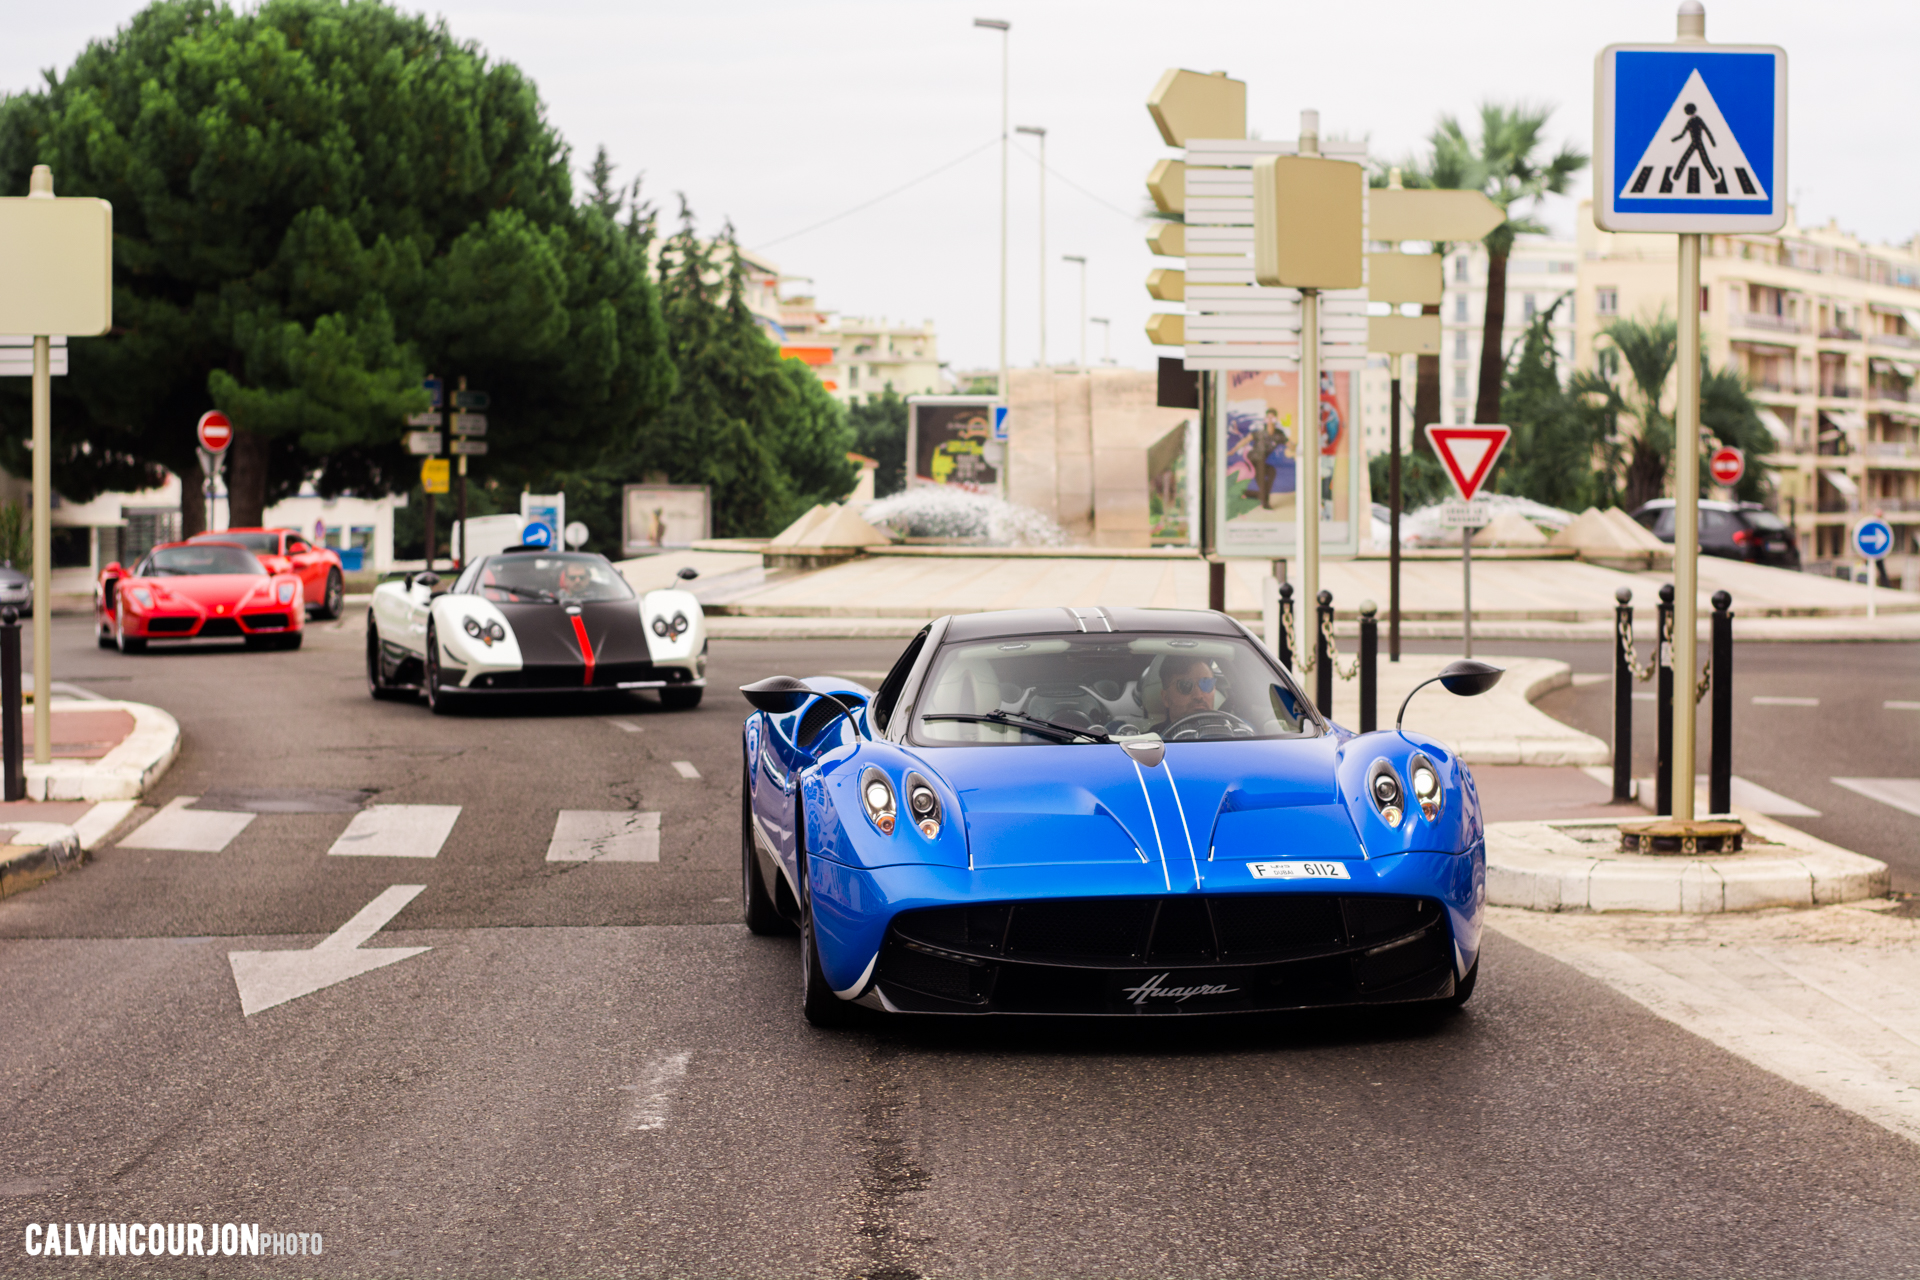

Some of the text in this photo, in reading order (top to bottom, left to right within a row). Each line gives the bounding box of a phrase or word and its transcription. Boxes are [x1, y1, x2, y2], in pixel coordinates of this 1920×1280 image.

[1254, 863, 1340, 877] F 6112
[1122, 972, 1240, 1005] Huayra
